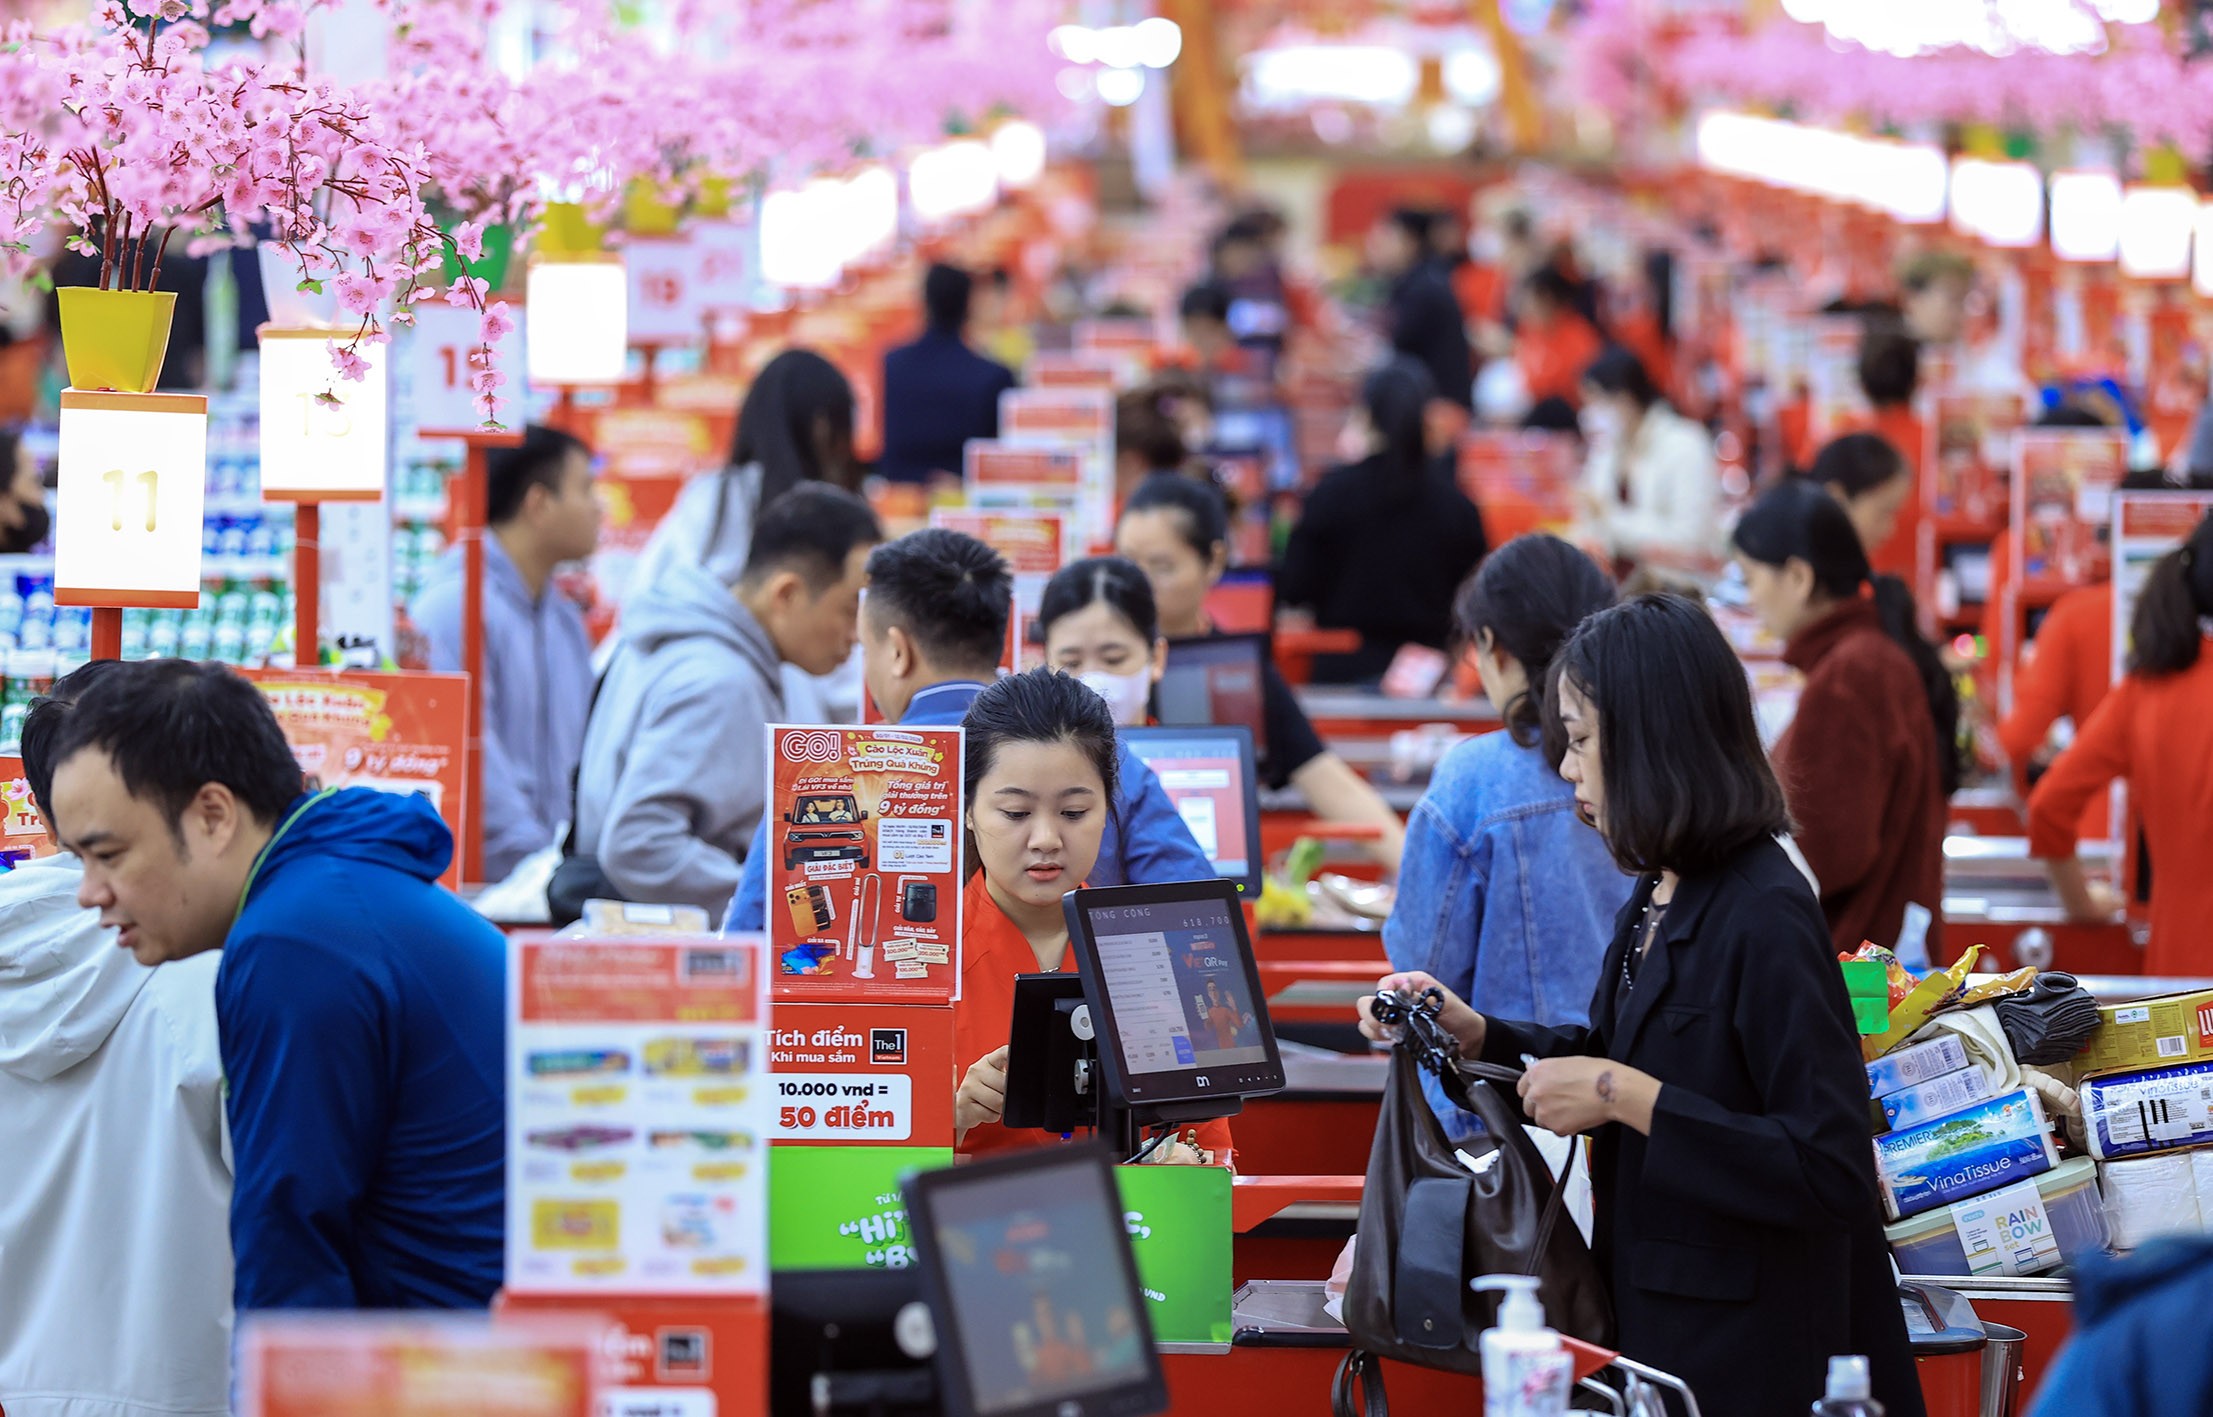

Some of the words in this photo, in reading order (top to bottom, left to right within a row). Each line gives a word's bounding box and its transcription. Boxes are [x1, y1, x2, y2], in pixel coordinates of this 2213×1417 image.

[102, 469, 158, 532] 11
[781, 730, 841, 763] GO!
[887, 745, 904, 755] Lộc
[879, 800, 891, 814] 9
[765, 1029, 806, 1047] Tích
[811, 1025, 863, 1047] điểm
[771, 1051, 793, 1063] Khi
[796, 1053, 825, 1063] mua
[828, 1049, 856, 1063] sắm
[778, 1082, 838, 1096] 10.000
[842, 1082, 874, 1096] vnd
[779, 1105, 816, 1128] 50
[824, 1099, 894, 1128] điểm
[1883, 1130, 1932, 1154] PREMIER
[1926, 1157, 2012, 1192] VinaTissue
[1995, 1205, 2039, 1230] RAIN
[2000, 1218, 2042, 1243] BOW
